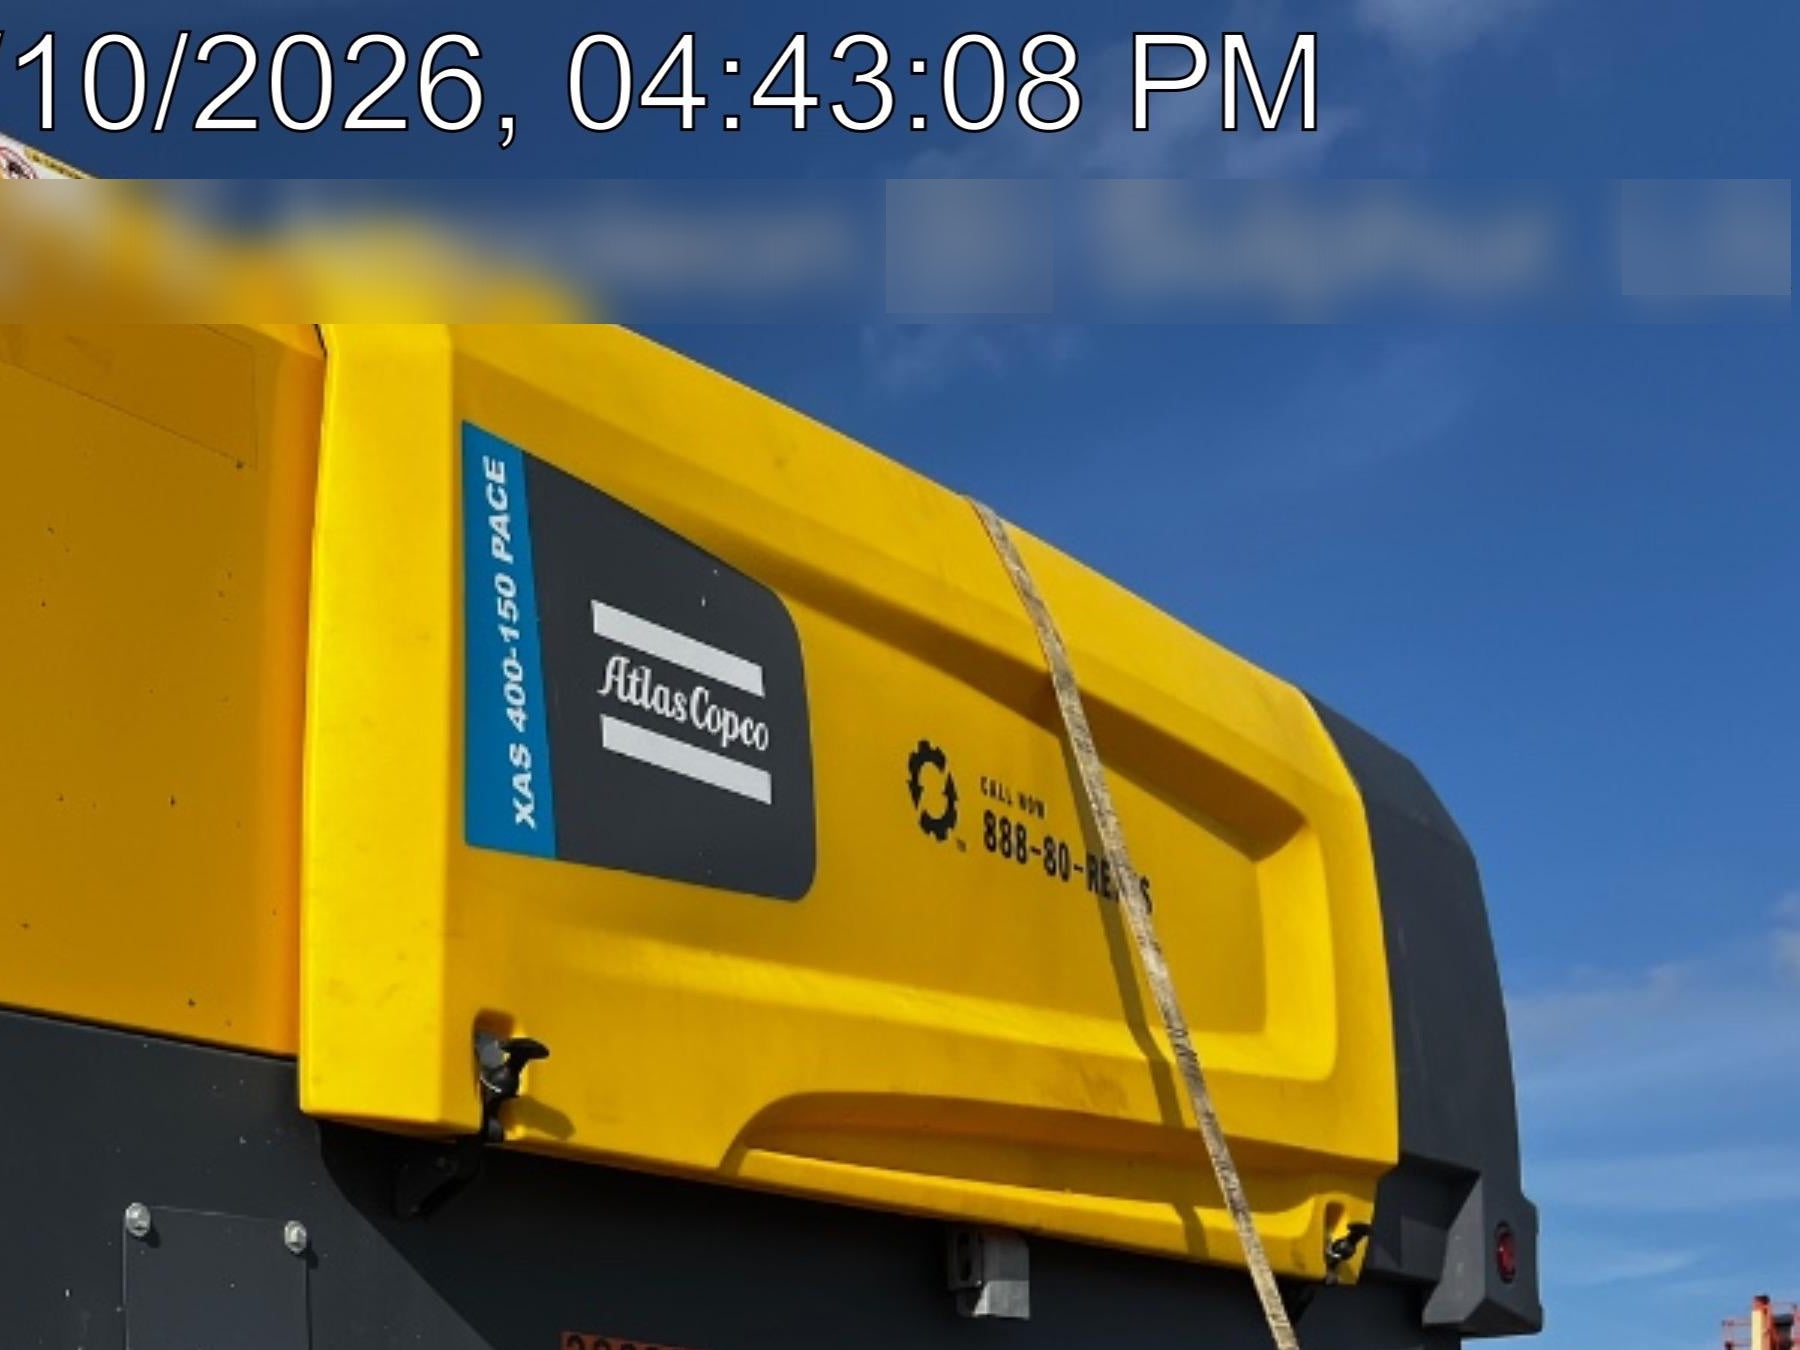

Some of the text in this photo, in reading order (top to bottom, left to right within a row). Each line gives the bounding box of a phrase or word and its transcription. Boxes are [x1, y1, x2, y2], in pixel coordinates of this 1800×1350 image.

[481, 454, 537, 830] XAS 400-150 PACE
[983, 809, 1153, 915] 888-80-RES
